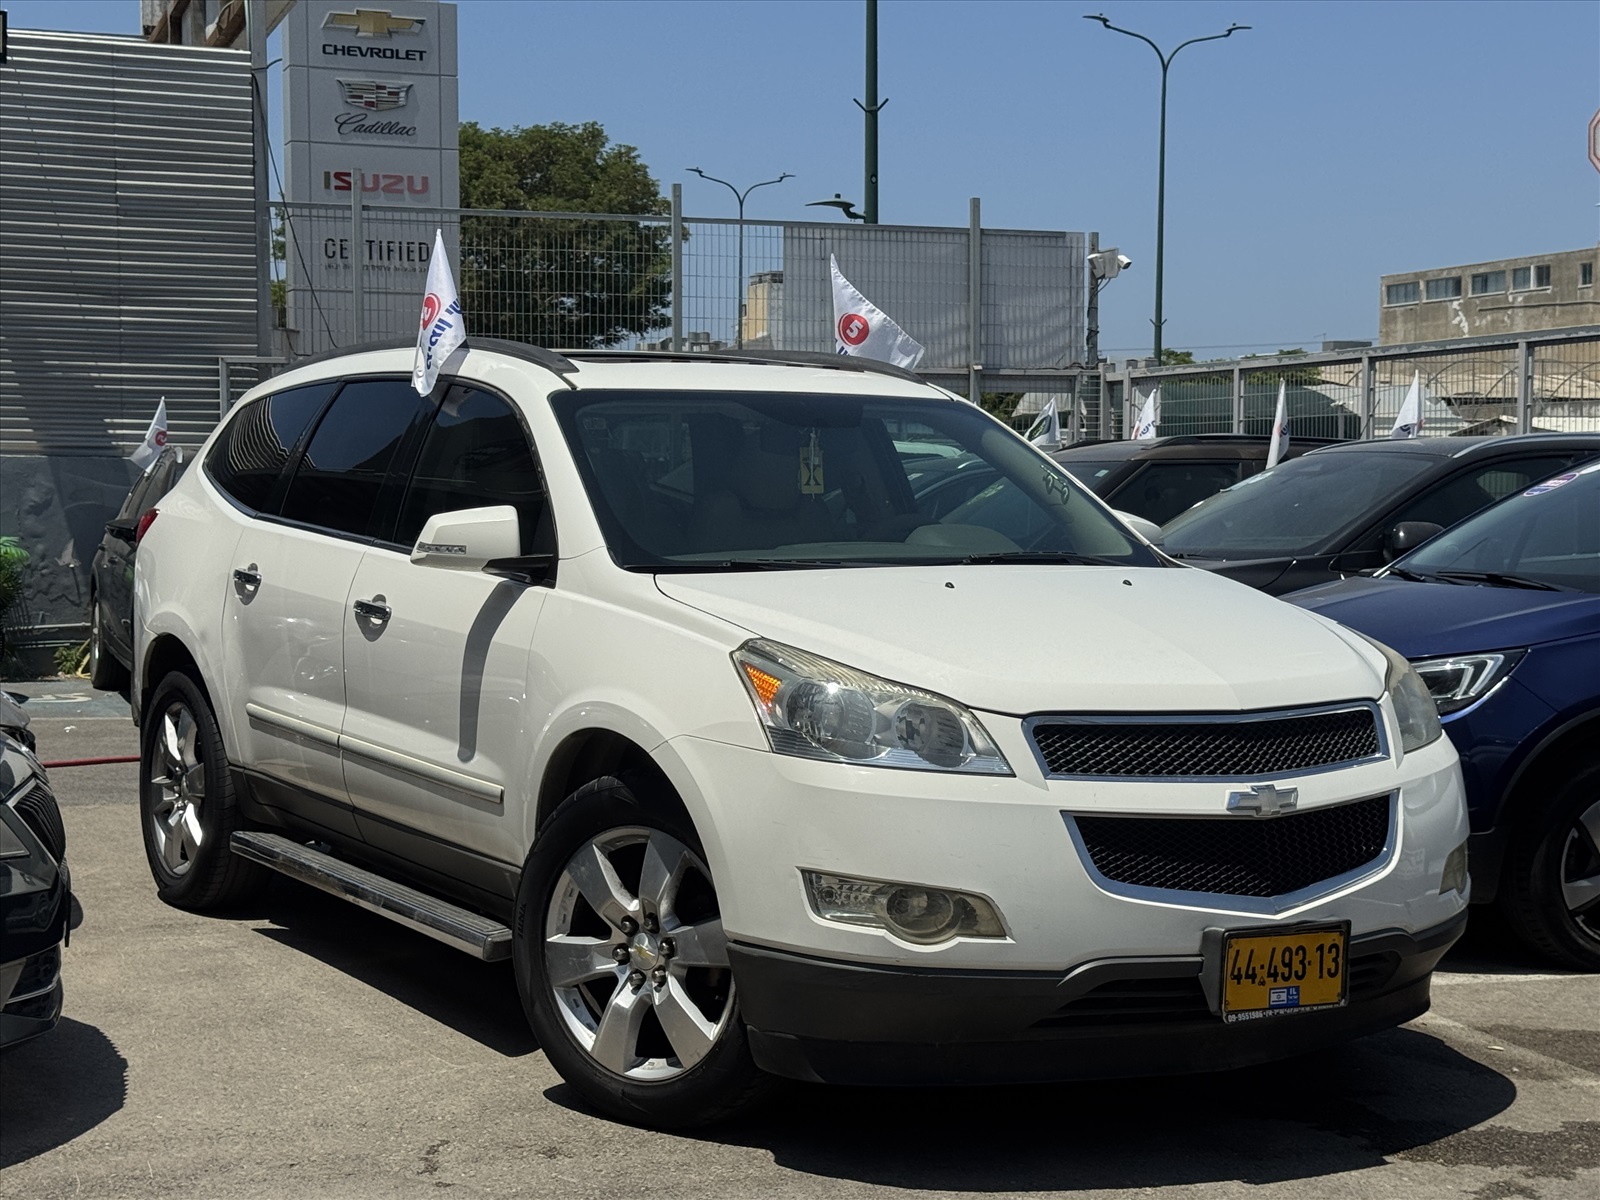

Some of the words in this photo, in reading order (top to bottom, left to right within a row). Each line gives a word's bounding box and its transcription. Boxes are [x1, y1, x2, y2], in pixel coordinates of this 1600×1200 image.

[322, 44, 427, 61] CHEVROLET
[335, 113, 416, 136] Cadillac
[324, 171, 429, 195] ISUZU
[325, 238, 430, 262] CETIFIED
[845, 319, 864, 338] 5
